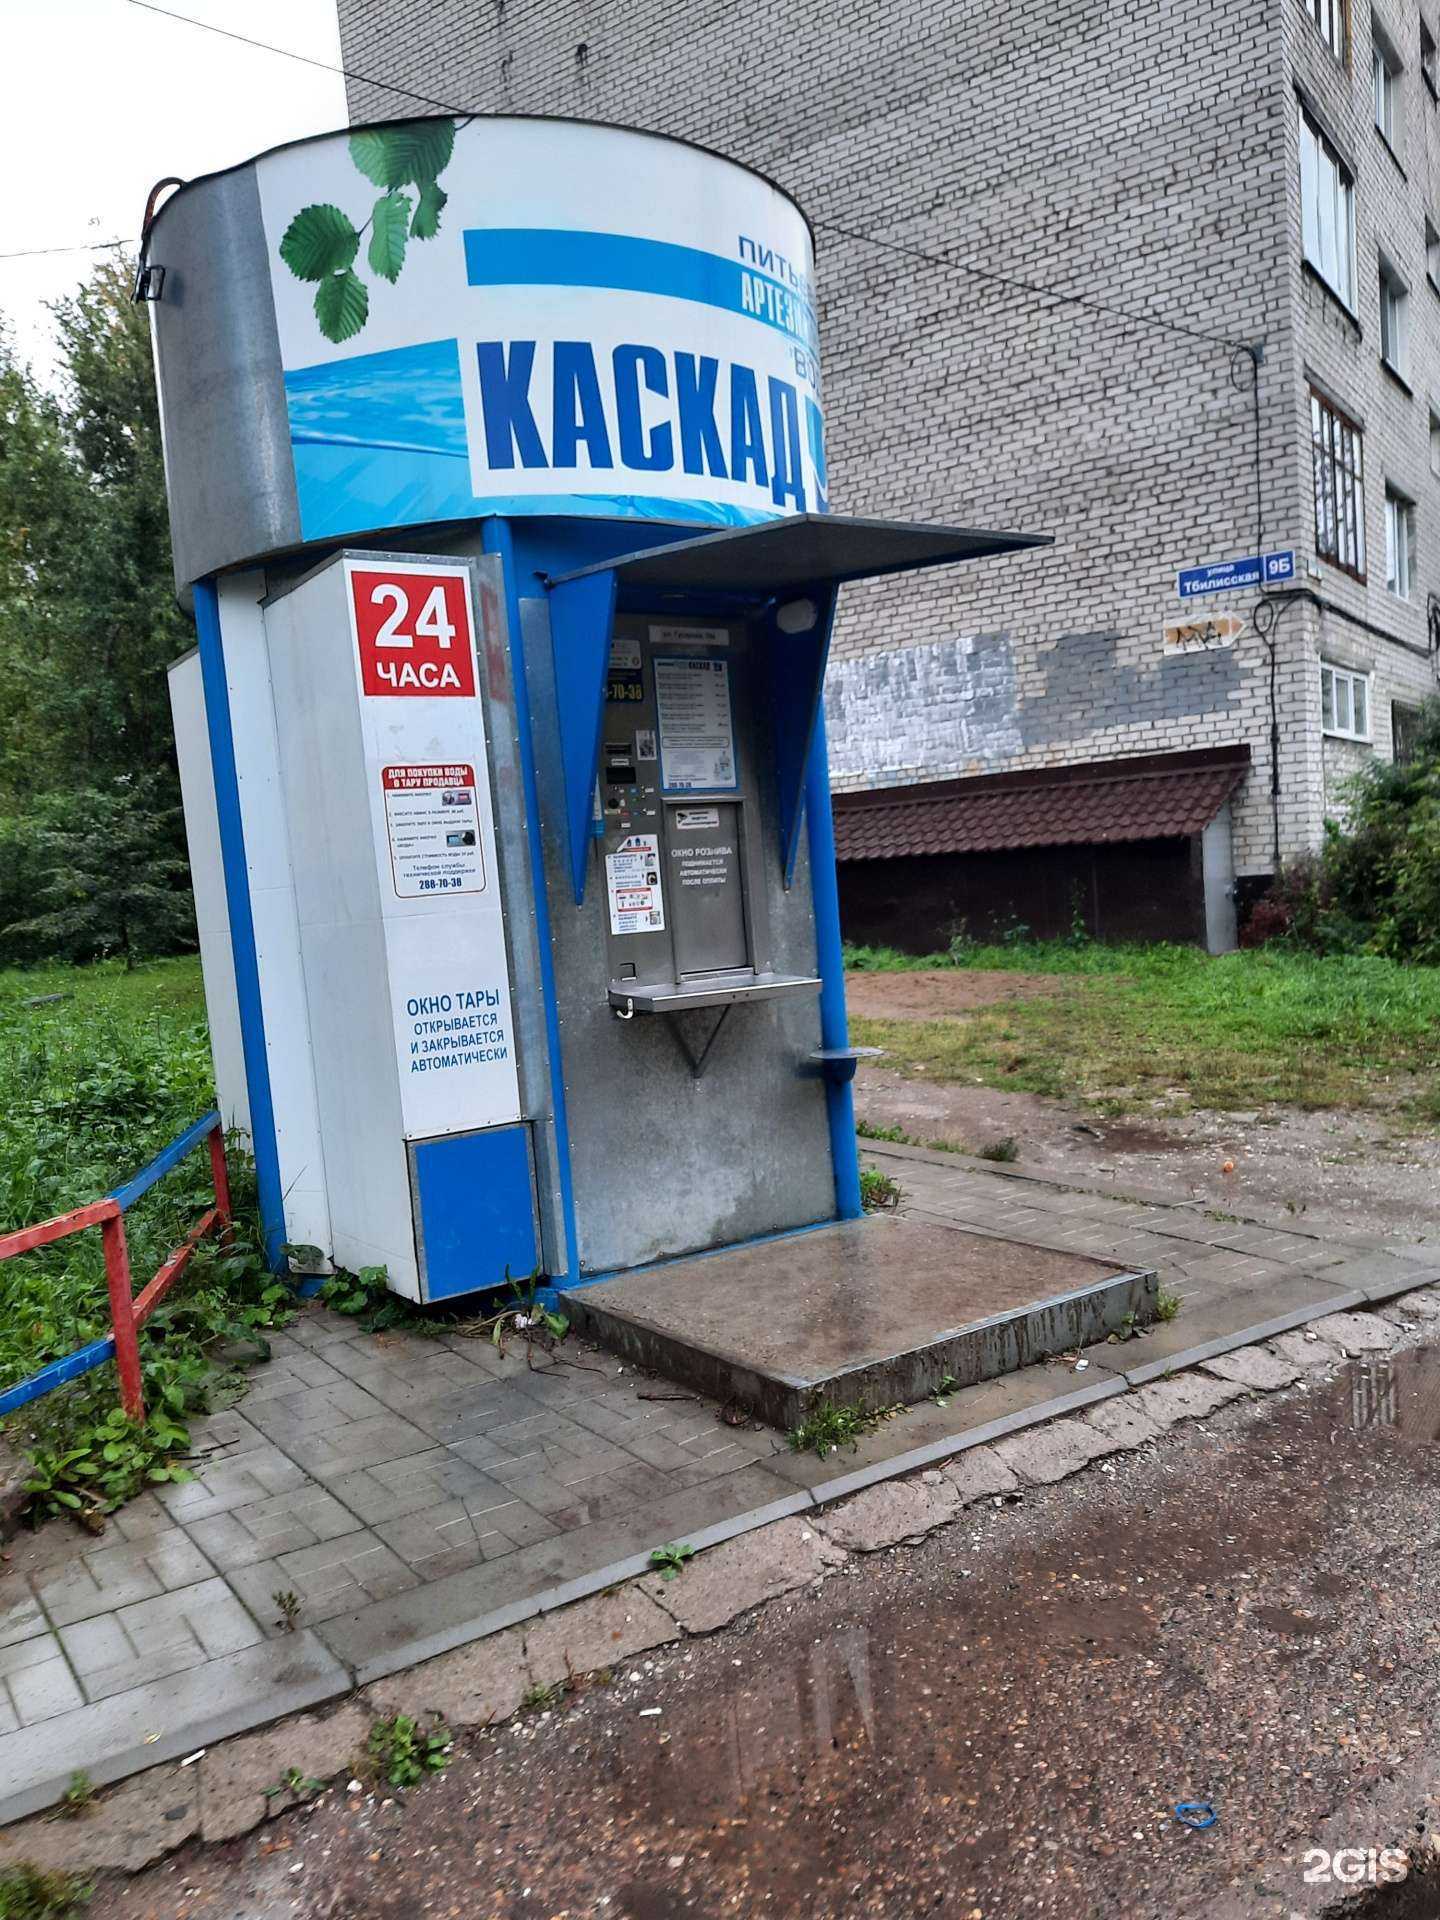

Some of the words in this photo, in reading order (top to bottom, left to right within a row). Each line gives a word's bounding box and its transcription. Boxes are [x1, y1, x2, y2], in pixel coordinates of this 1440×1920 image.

[476, 340, 806, 513] КАСКАД
[1183, 571, 1260, 594] Тбилисская
[1268, 556, 1291, 575] 9Б
[370, 583, 456, 649] 24
[376, 662, 462, 688] ЧАСА
[407, 994, 452, 1016] ОКНО
[455, 989, 500, 1010] ТАРЫ
[414, 1012, 498, 1036] ОТКРЫВАЕТСЯ
[410, 1041, 419, 1054] И
[421, 1029, 505, 1053] ЗАКРЫВАЕТСЯ
[410, 1047, 508, 1073] АВТОМАТИЧЕСКИ
